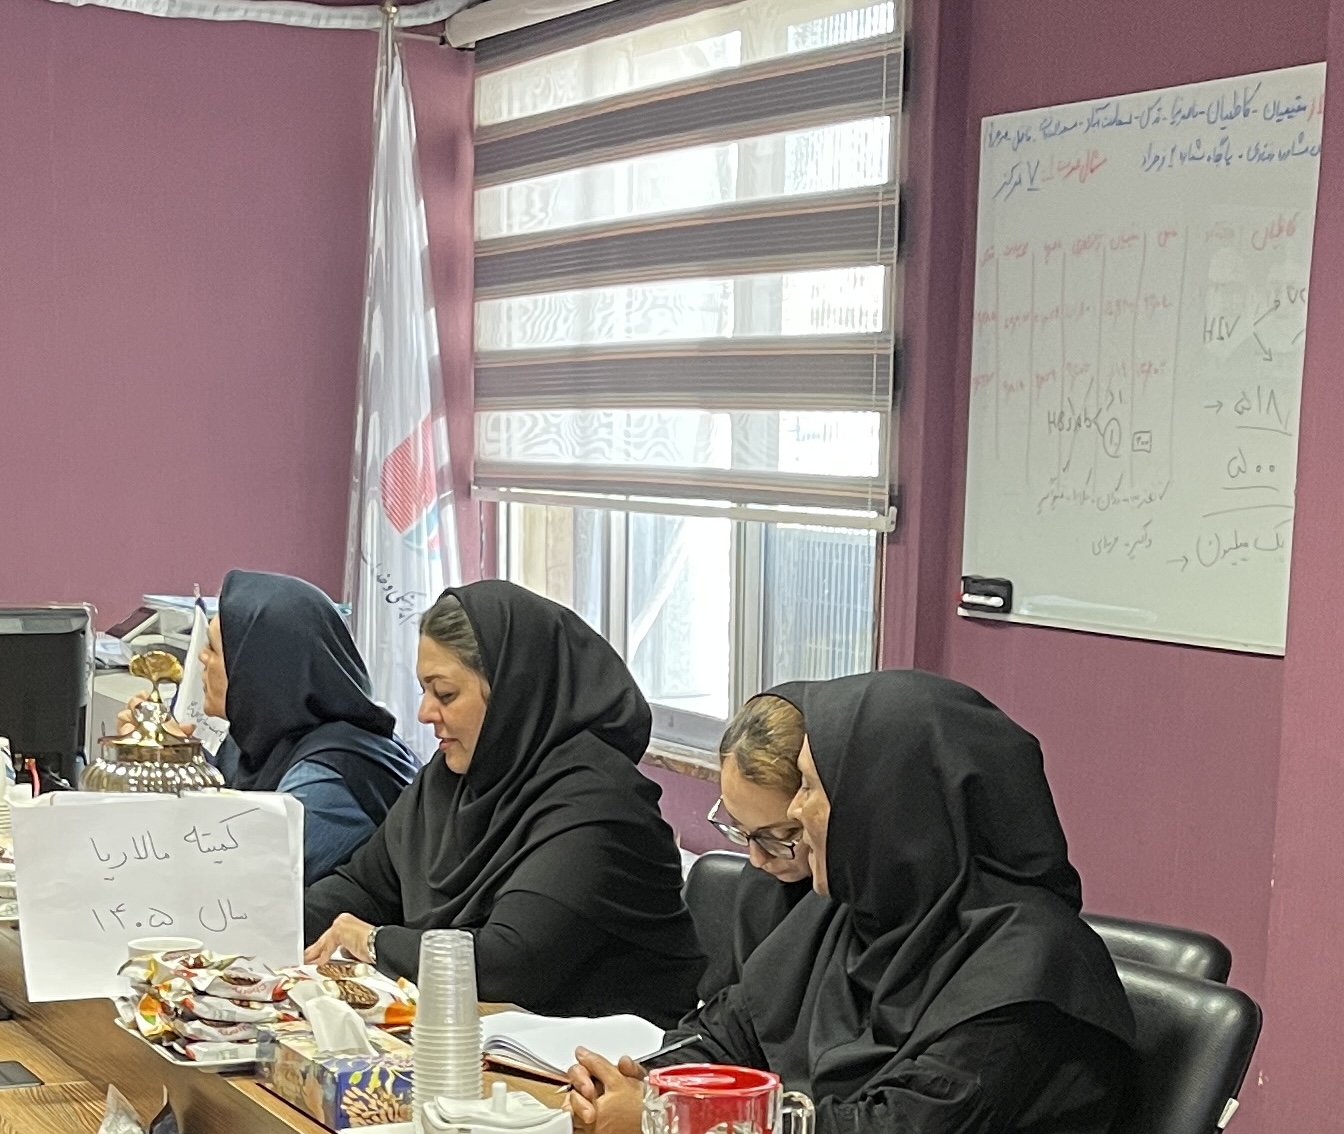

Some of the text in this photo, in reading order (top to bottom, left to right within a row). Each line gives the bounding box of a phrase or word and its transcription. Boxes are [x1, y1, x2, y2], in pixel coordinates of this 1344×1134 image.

[1202, 315, 1241, 344] HIV
[89, 807, 260, 882] کمیته مالاریا
[91, 899, 248, 933] سال ۱۴۰۵
